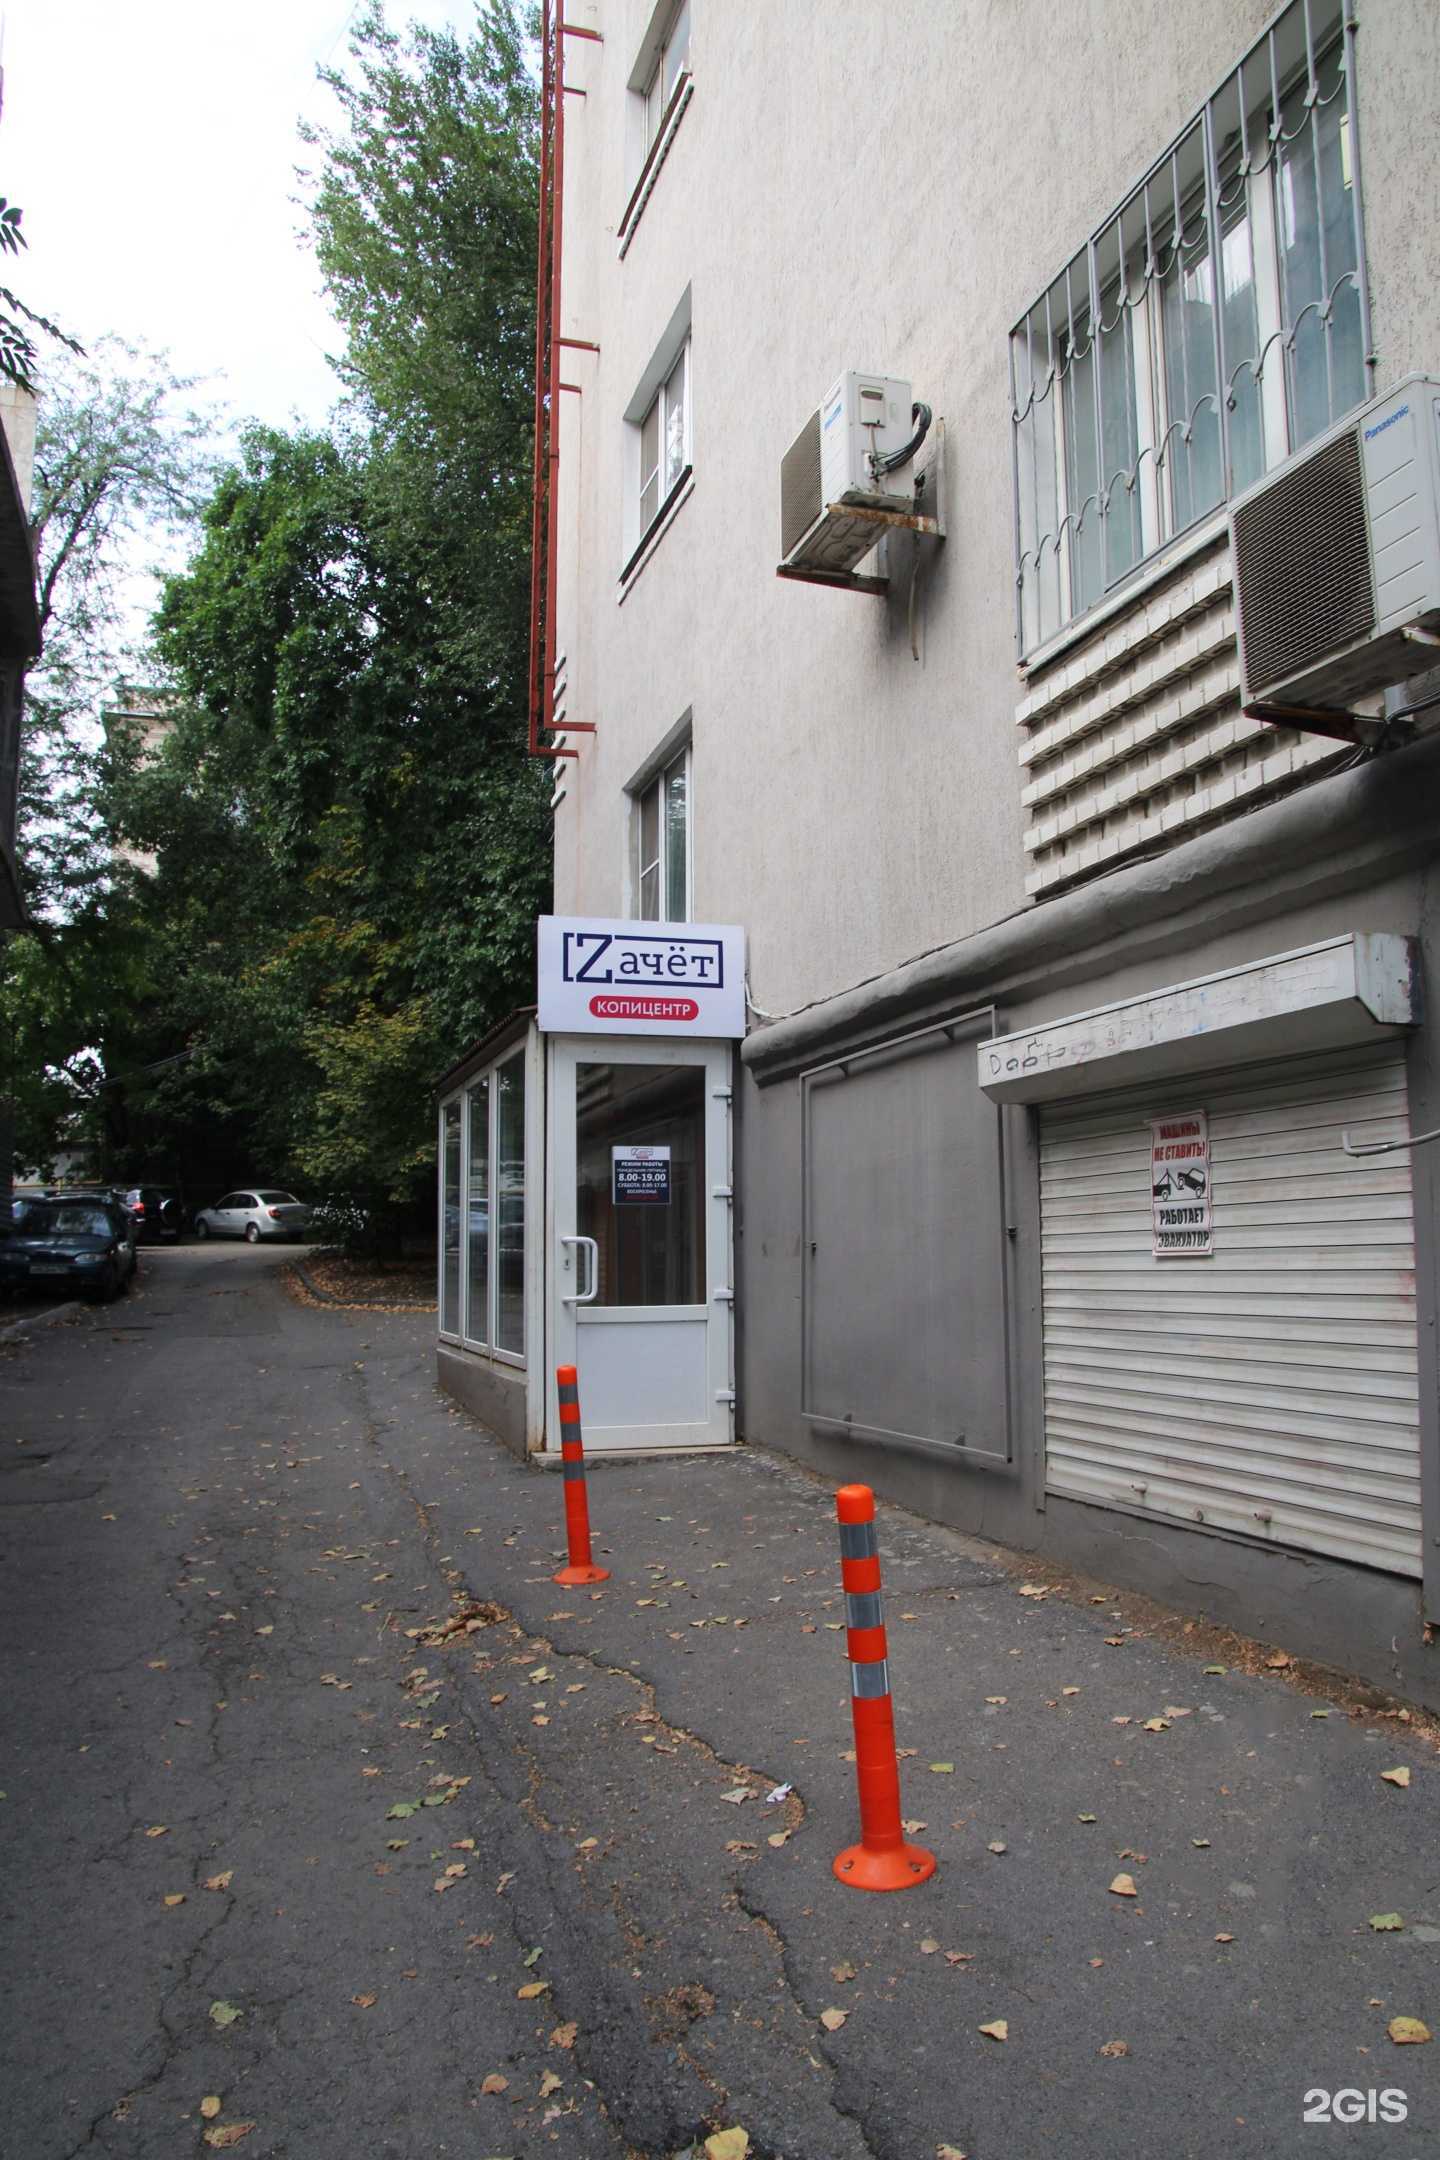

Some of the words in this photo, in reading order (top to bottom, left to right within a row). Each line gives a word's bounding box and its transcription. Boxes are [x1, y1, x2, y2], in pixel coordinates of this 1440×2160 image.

[1365, 405, 1409, 442] Panasonic
[597, 1000, 691, 1017] КОПИЦЕНТР
[1159, 1121, 1201, 1140] МАШИНЫ
[1153, 1145, 1165, 1162] НЕ
[1165, 1141, 1206, 1161] СТАВИТЬ!
[618, 1173, 666, 1182] 8.00-19.00
[1159, 1206, 1205, 1226] РАБОТАЕТ
[1158, 1230, 1210, 1248] ЭВАКУАТОР
